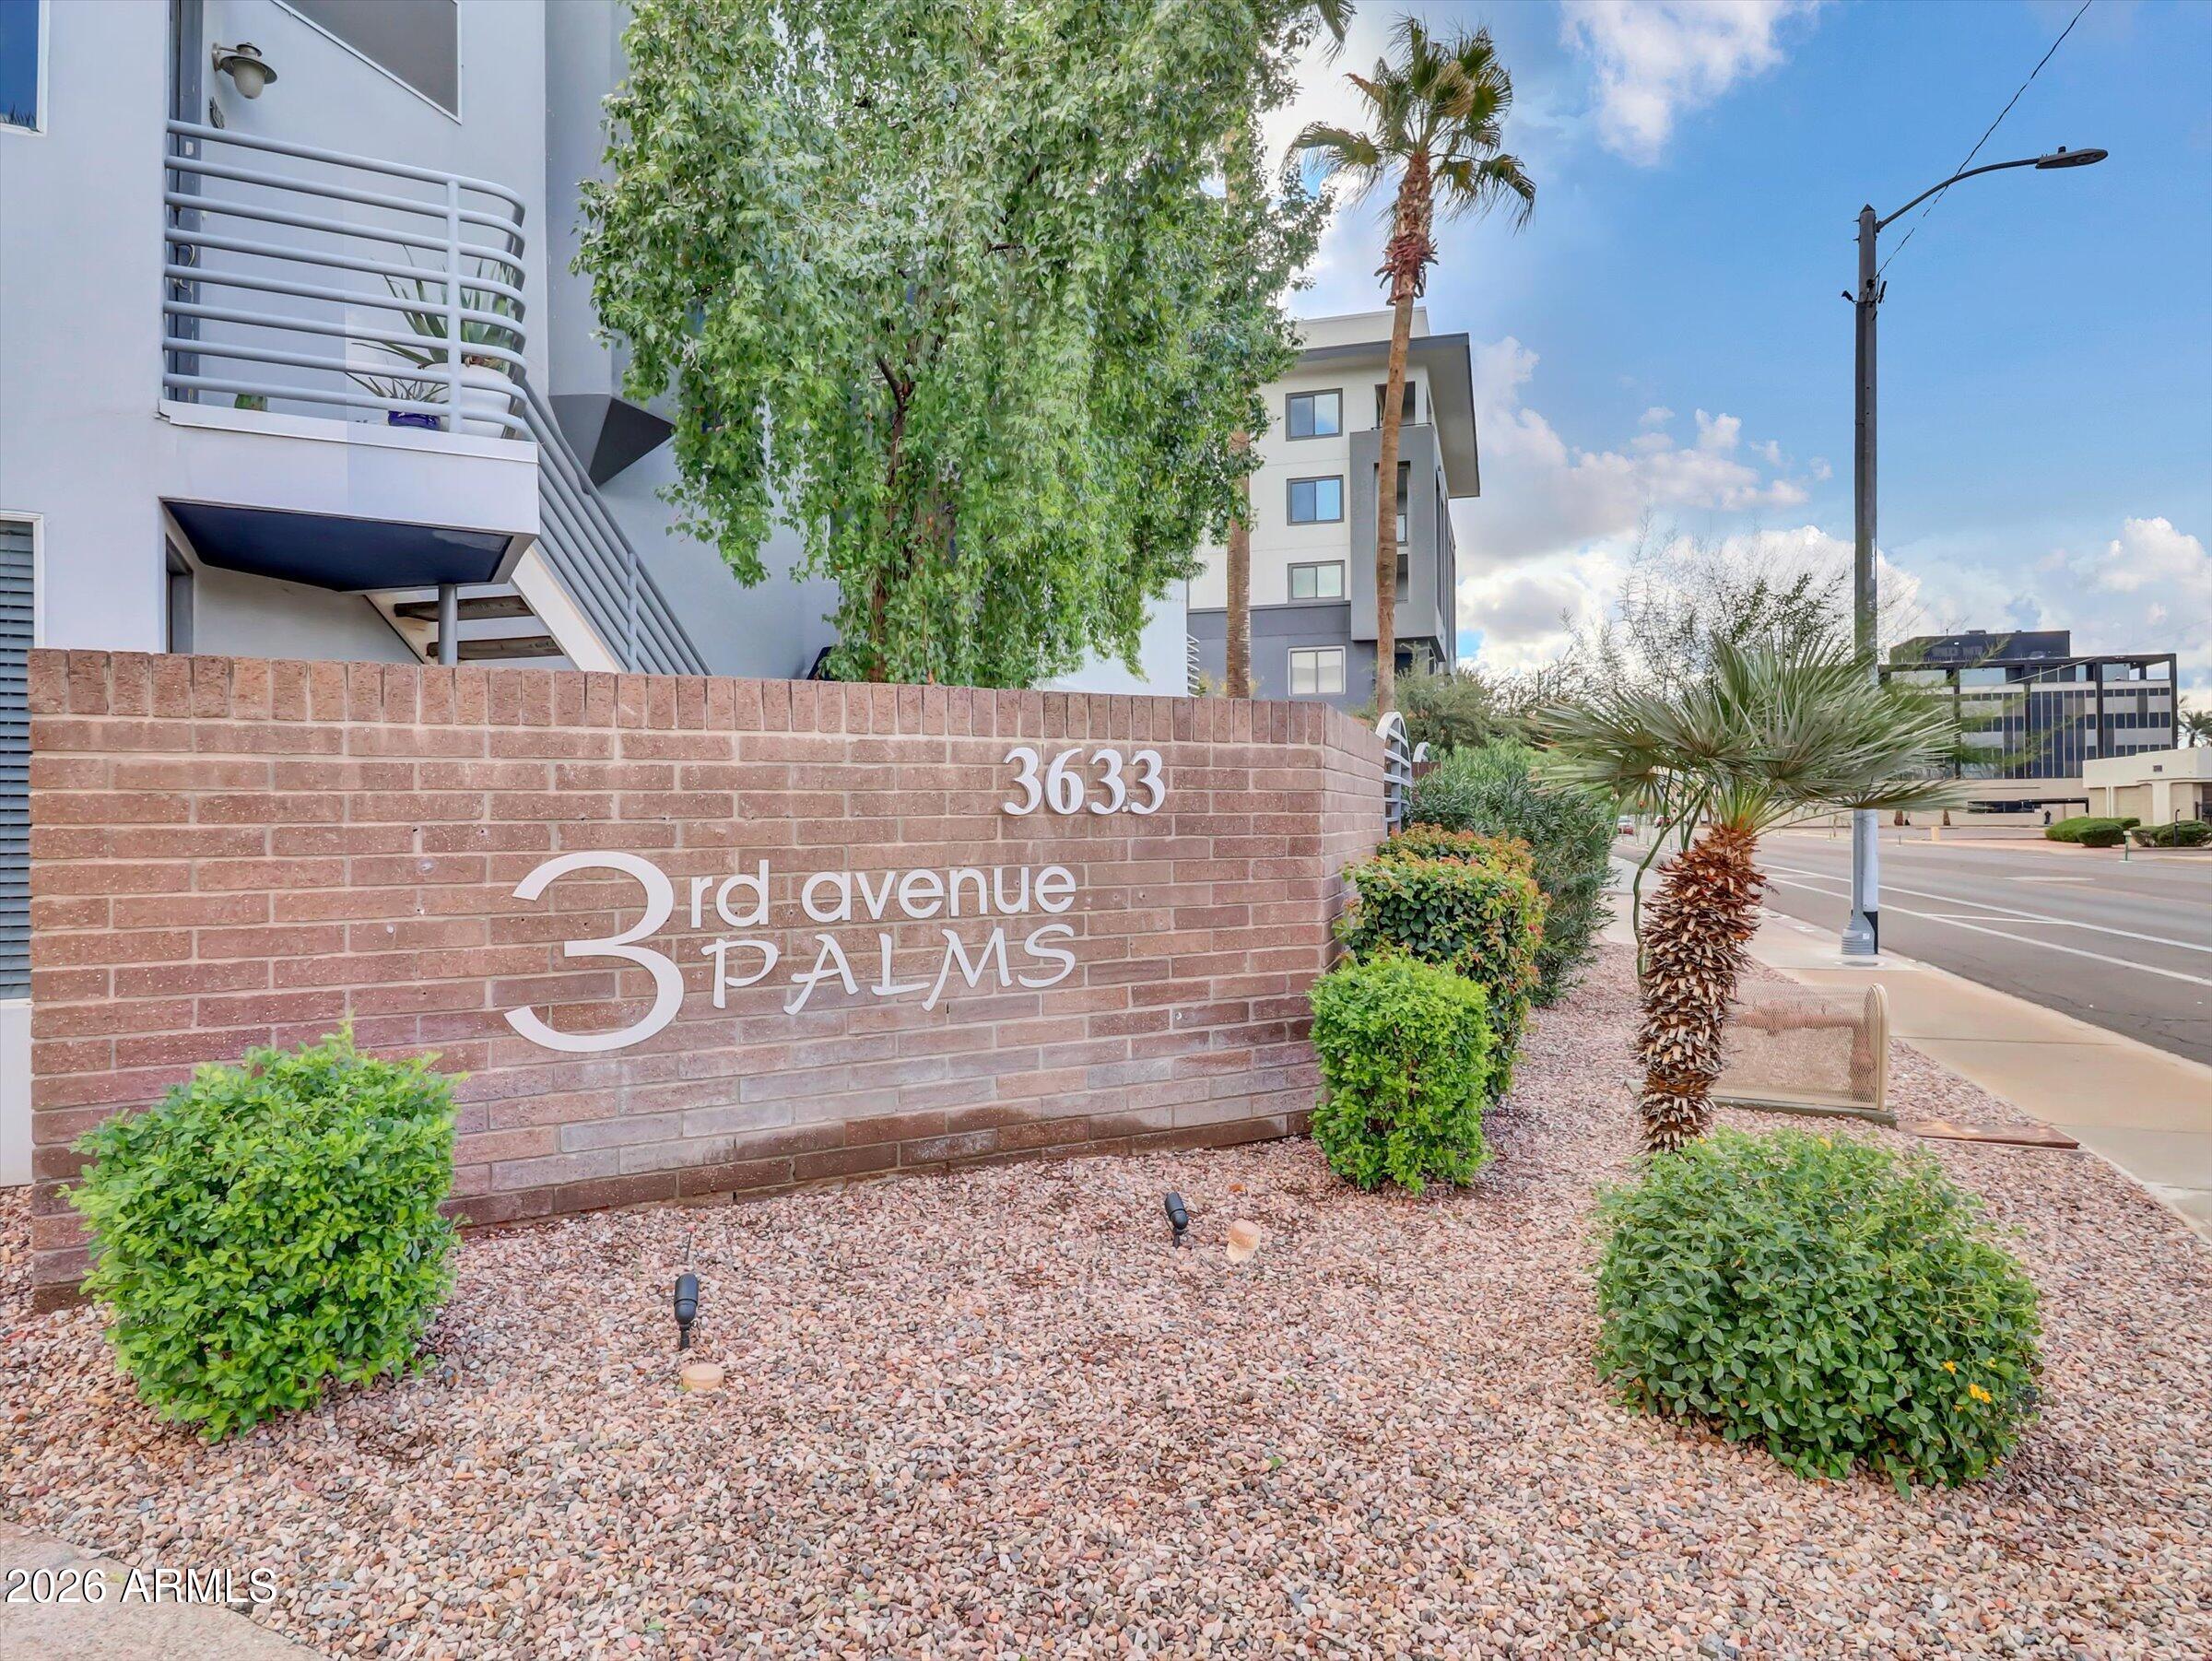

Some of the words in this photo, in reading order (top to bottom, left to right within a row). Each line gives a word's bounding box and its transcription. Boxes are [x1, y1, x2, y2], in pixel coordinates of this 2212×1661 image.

[1002, 747, 1166, 815] 3633
[504, 851, 771, 1053] 3rd
[802, 866, 1077, 921] avenue
[701, 924, 1077, 1015] PALMS
